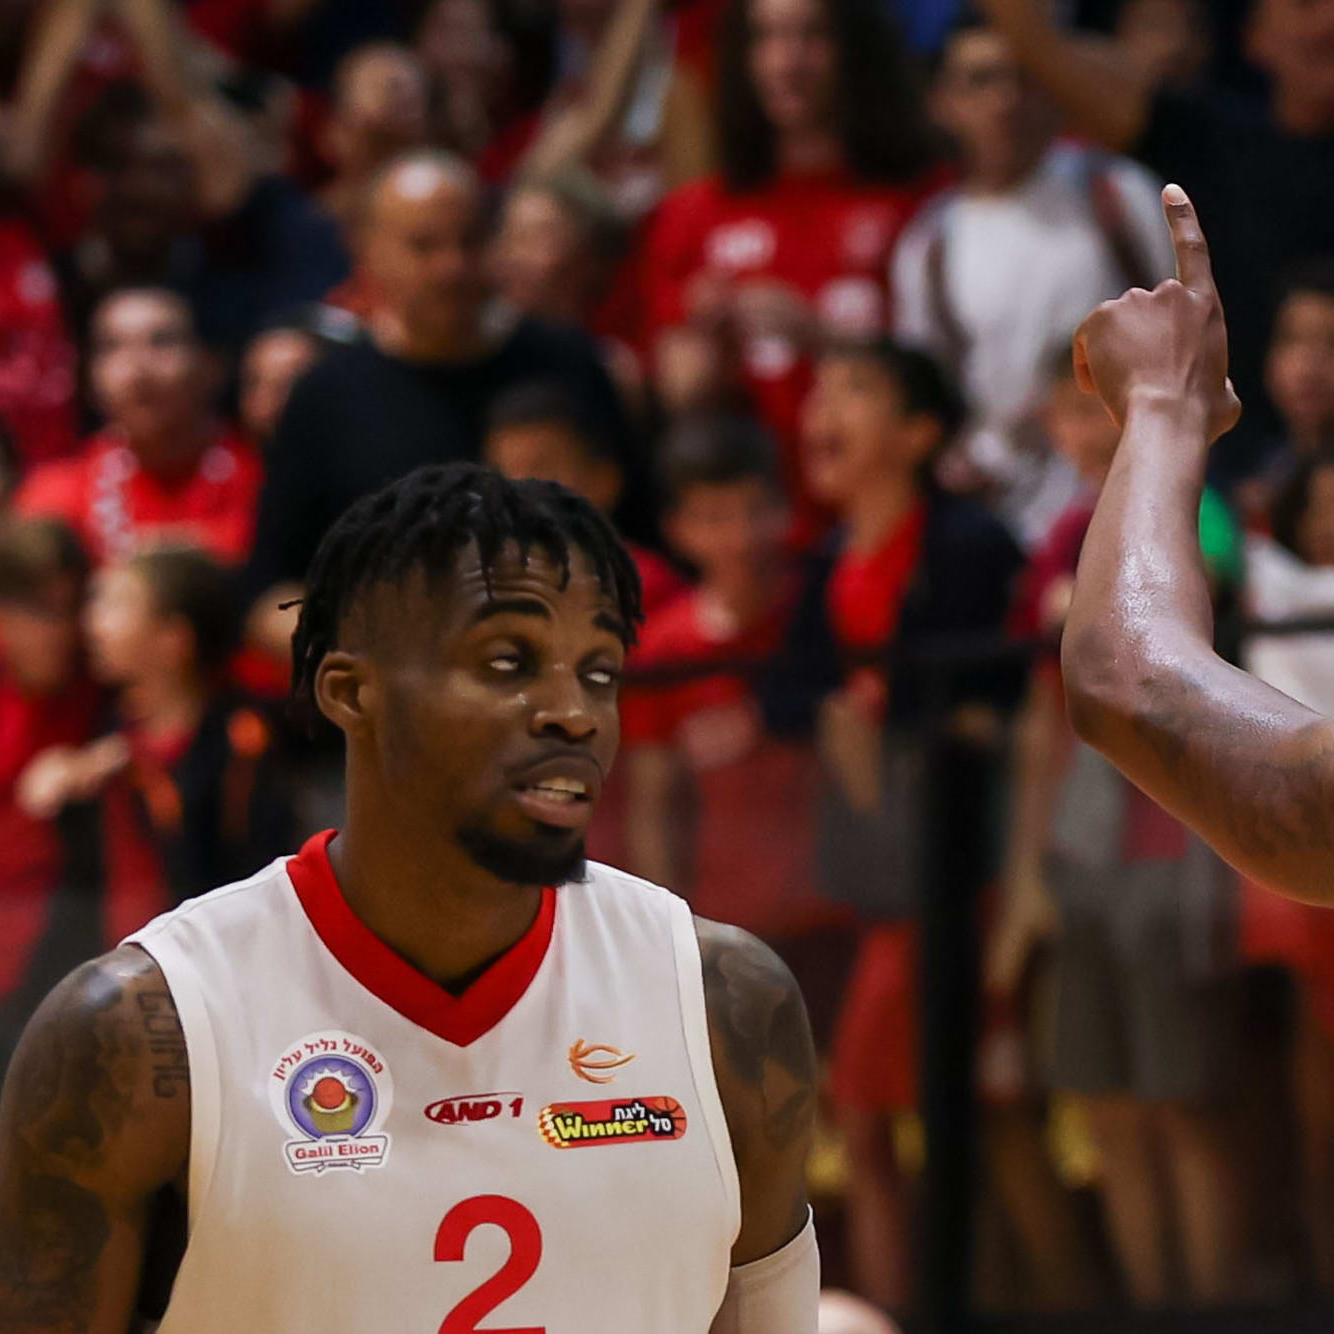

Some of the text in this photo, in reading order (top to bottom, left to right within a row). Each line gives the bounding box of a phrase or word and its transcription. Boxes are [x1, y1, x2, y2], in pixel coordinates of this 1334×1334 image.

[273, 1050, 303, 1081] עליון
[434, 1097, 524, 1123] AND 1
[615, 1102, 645, 1121] ליגת
[649, 1113, 672, 1132] סל
[295, 1143, 379, 1159] Galil Elion
